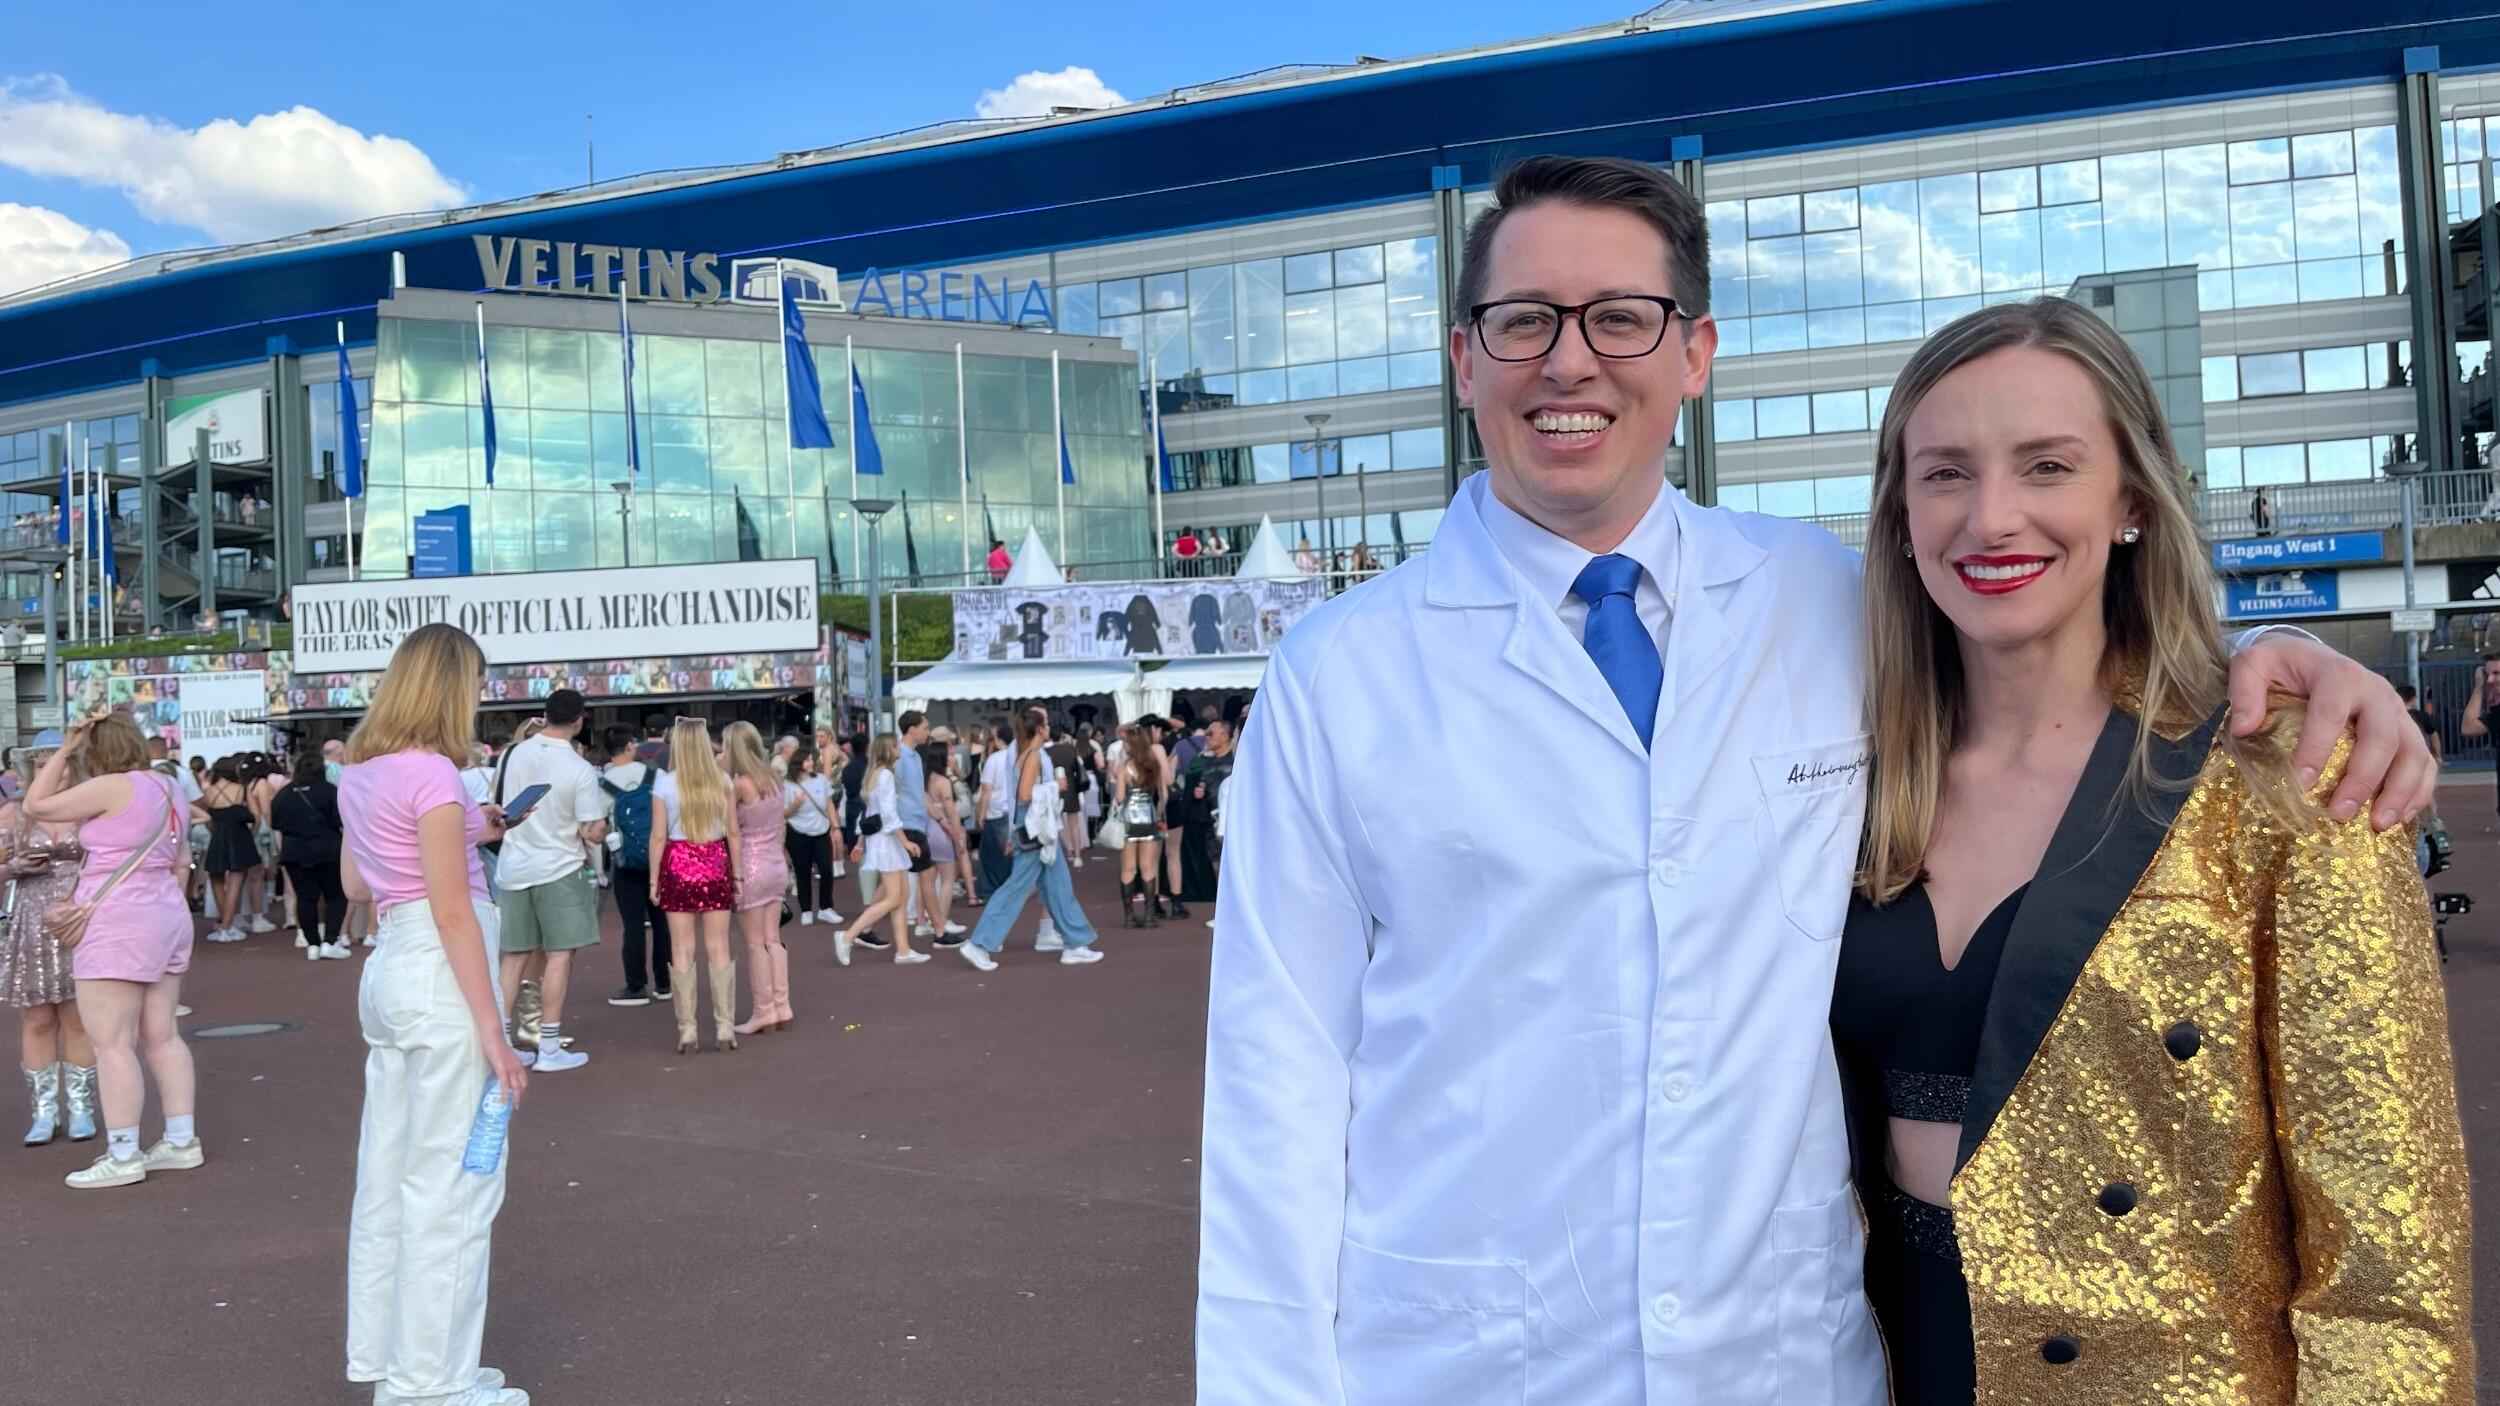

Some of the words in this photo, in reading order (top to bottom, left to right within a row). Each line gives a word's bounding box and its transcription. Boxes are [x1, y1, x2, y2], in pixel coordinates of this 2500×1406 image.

[472, 235, 722, 303] VELTINS
[852, 266, 1057, 328] ARENA
[188, 440, 242, 460] VTINS
[2221, 543, 2283, 559] Eingang
[2285, 539, 2325, 554] West
[2328, 538, 2337, 552] 1
[297, 598, 379, 634] TAYLOR
[385, 594, 450, 632] SWIFT
[459, 596, 591, 636] OFFICIAL
[599, 585, 812, 630] MERCHANDISE
[298, 636, 339, 653] THE
[345, 633, 393, 650] ERAS
[183, 710, 226, 729] TAYLOR
